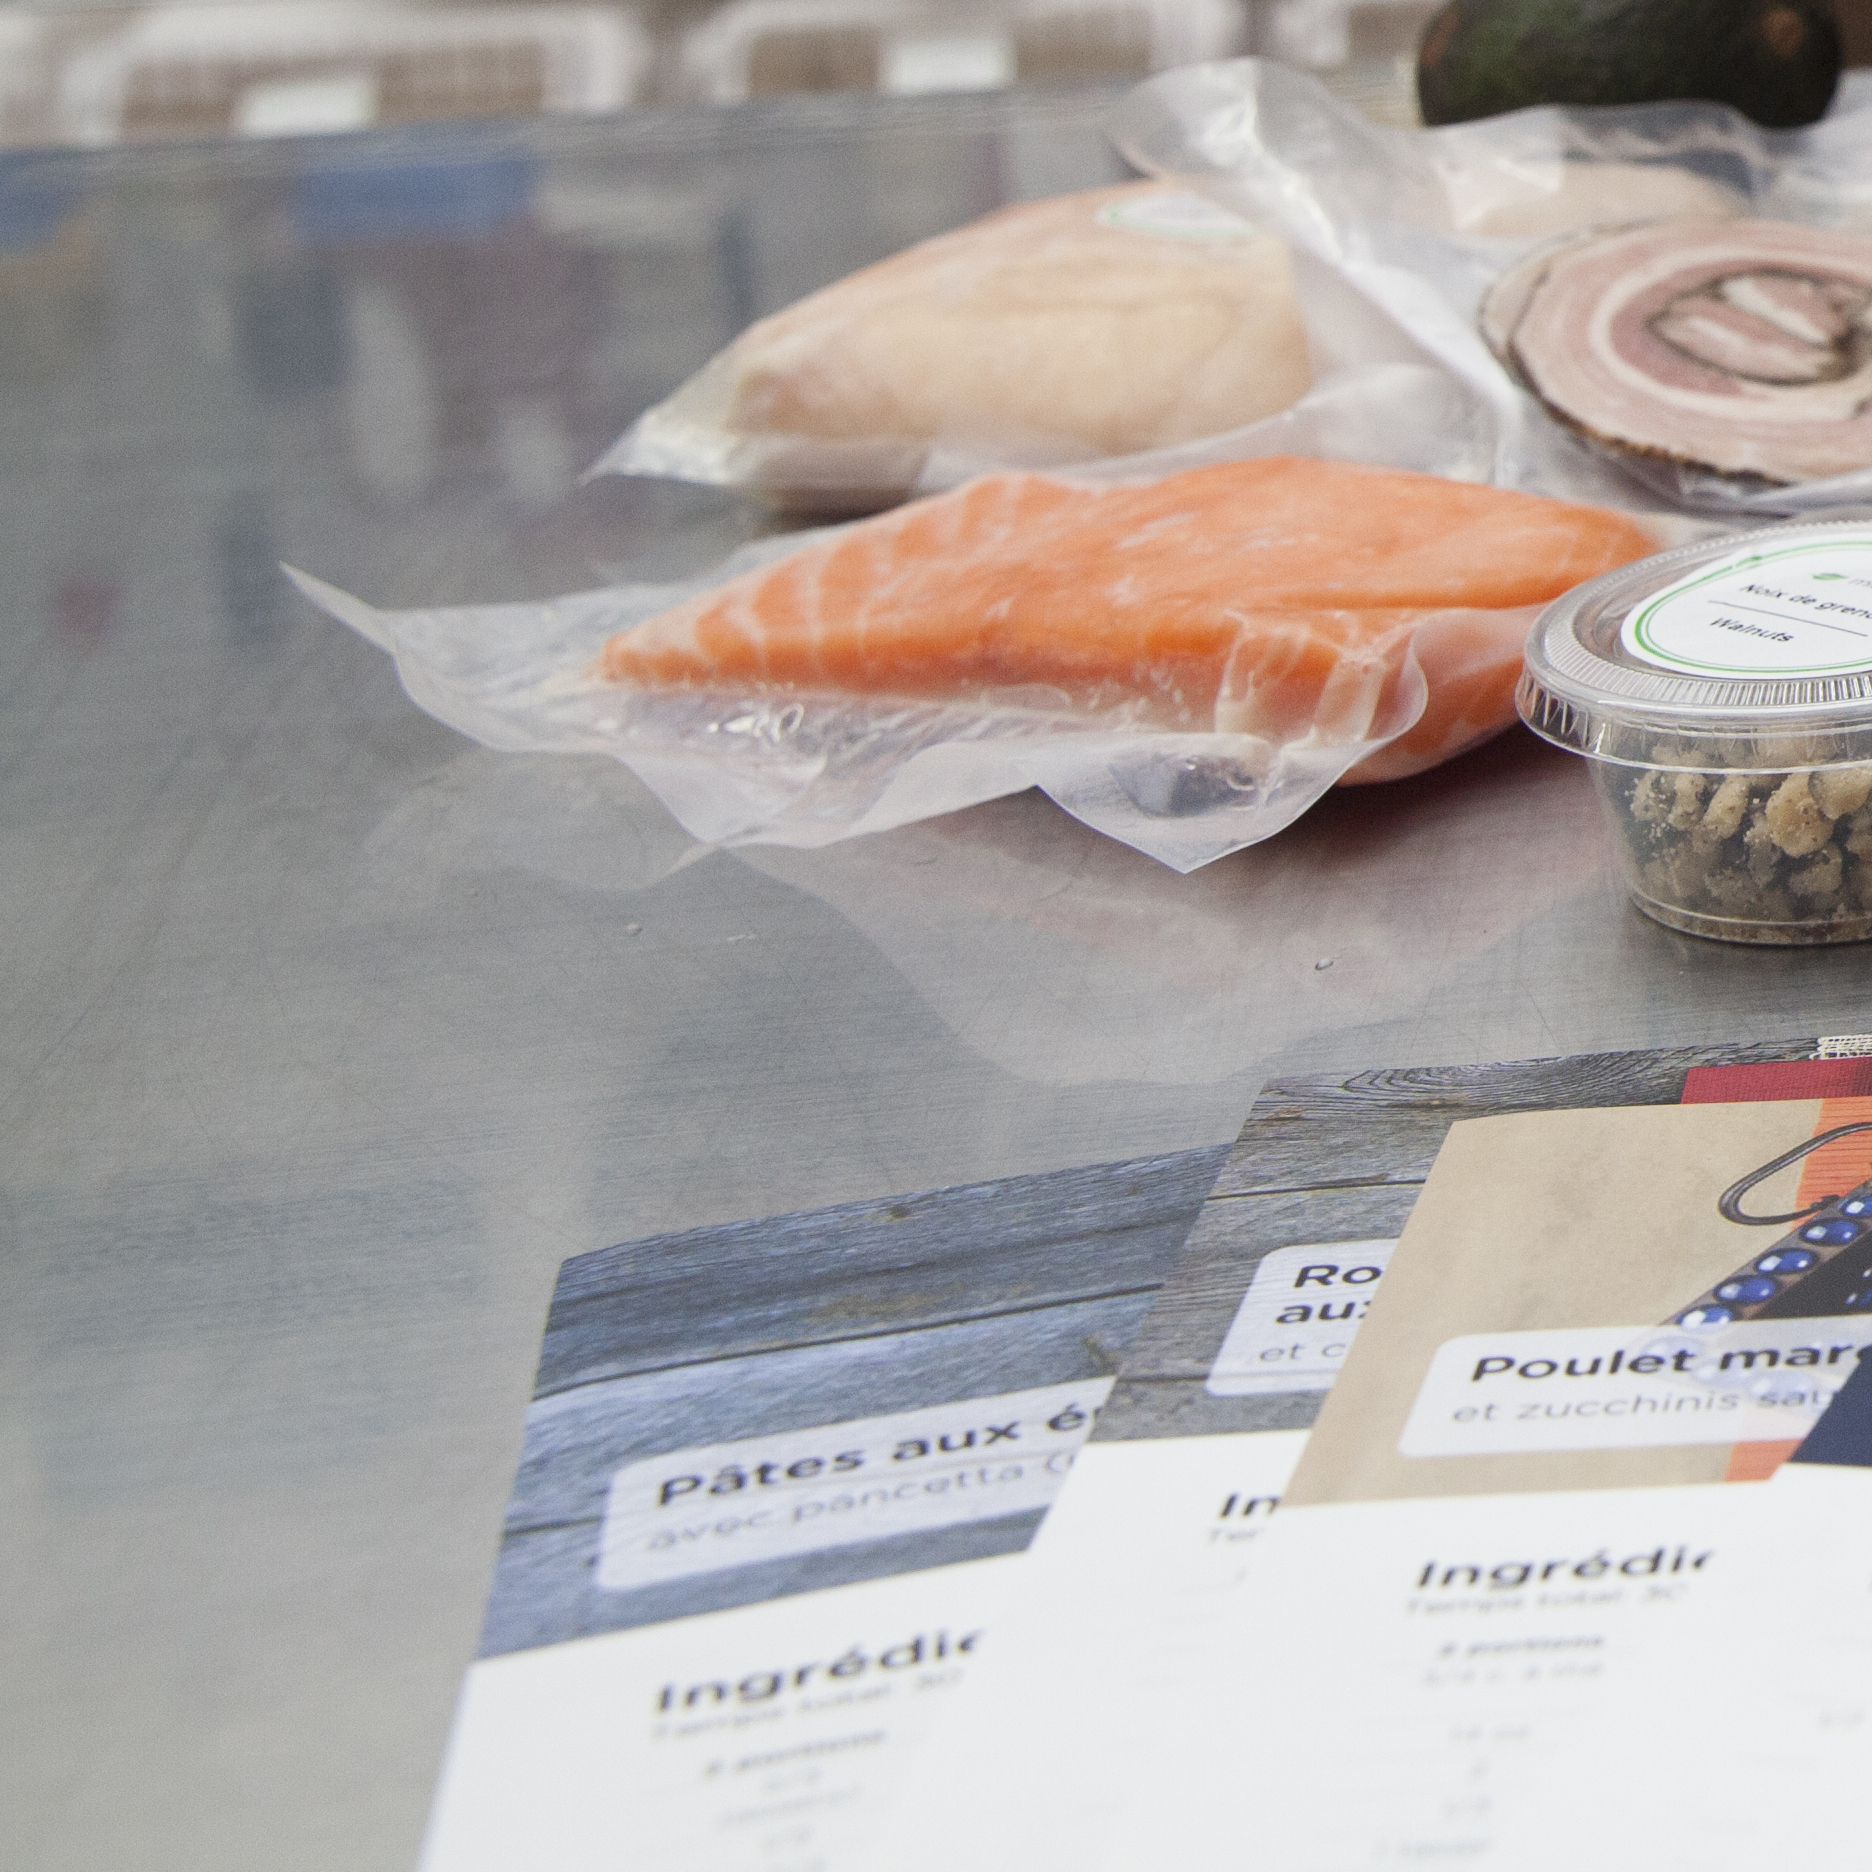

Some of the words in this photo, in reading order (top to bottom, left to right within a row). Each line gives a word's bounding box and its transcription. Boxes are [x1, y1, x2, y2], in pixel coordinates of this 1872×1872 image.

[1739, 583, 1787, 600] Noix
[1788, 593, 1818, 605] de
[1709, 617, 1795, 642] Walnuts
[1258, 1342, 1305, 1363] et
[1470, 1347, 1698, 1382] Poulet
[1452, 1400, 1499, 1424] et
[1515, 1389, 1739, 1421] zucchinis
[657, 1448, 866, 1507] Pâtes
[891, 1420, 1022, 1462] aux
[1047, 1401, 1102, 1432] é
[647, 1508, 773, 1552] avec
[792, 1463, 1026, 1523] pancetta
